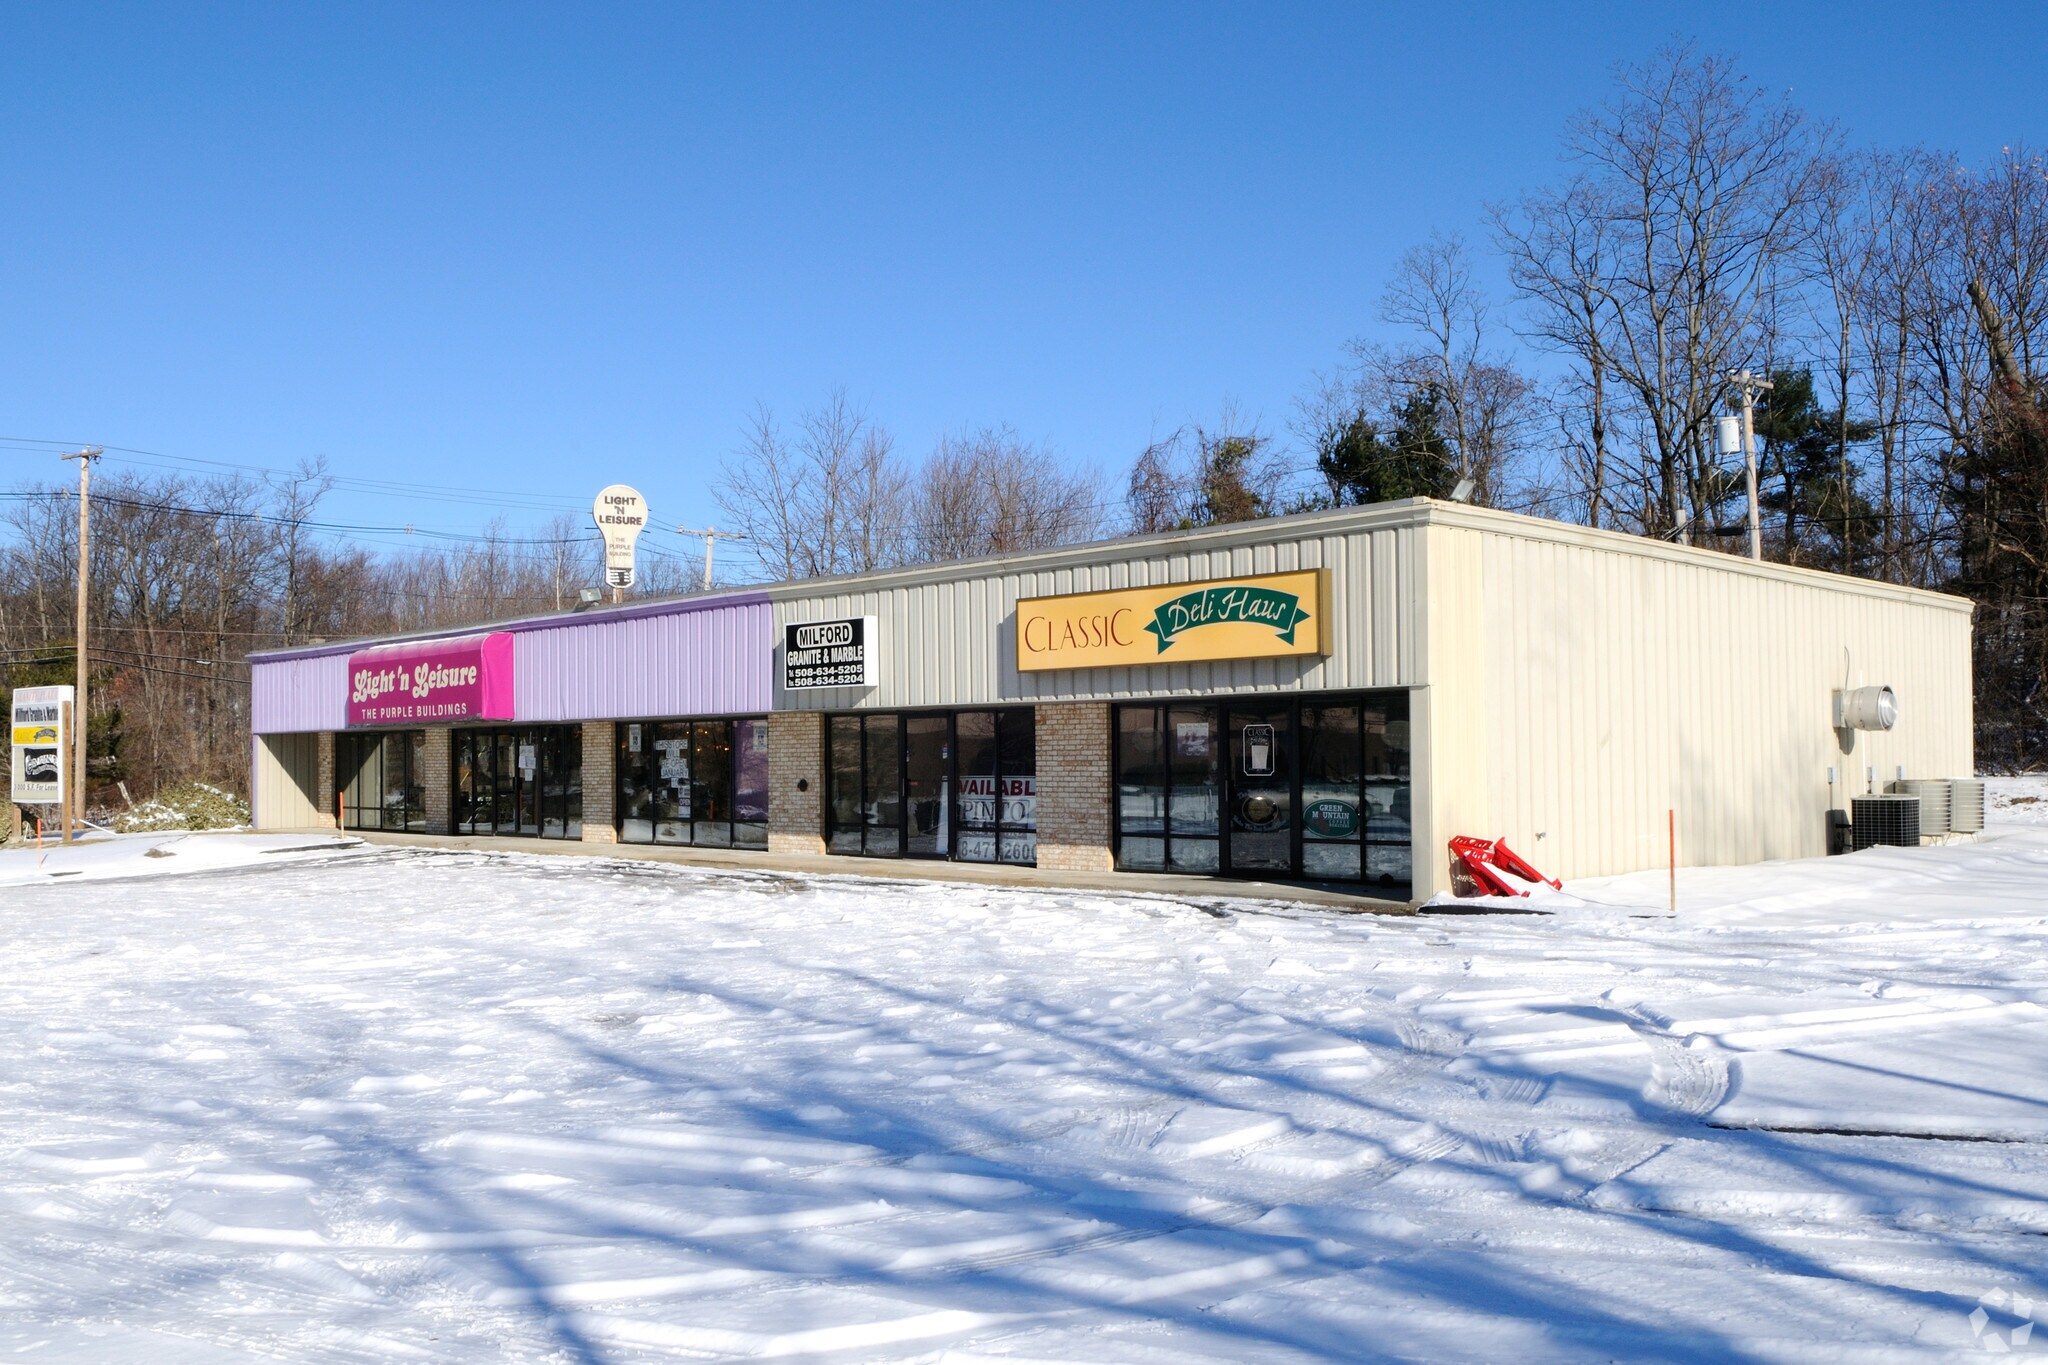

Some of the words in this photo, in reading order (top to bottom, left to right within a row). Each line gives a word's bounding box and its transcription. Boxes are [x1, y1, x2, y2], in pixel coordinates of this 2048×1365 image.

[604, 496, 637, 506] LIGHT
[614, 505, 625, 515] 'N
[599, 515, 642, 526] LEISURE
[609, 543, 632, 551] PURPLE
[1168, 589, 1214, 633] Deli
[1218, 589, 1286, 620] Haus
[799, 625, 850, 646] MILFORD
[1024, 608, 1133, 653] CLASSIC
[787, 648, 822, 667] GRANITE
[823, 648, 830, 664] &
[831, 645, 863, 663] MARBLE
[794, 664, 863, 678] 508-634-5205
[352, 669, 395, 704] Light
[412, 662, 478, 699] Leisure
[794, 674, 864, 687] 508-634-5204
[361, 708, 377, 720] THE
[380, 705, 413, 718] PURPLE
[416, 702, 467, 717] BUILDINGS
[662, 768, 688, 777] JANUARY
[959, 779, 1036, 797] VAILABL
[963, 800, 1026, 822] PINTO
[1319, 804, 1343, 813] GREEN
